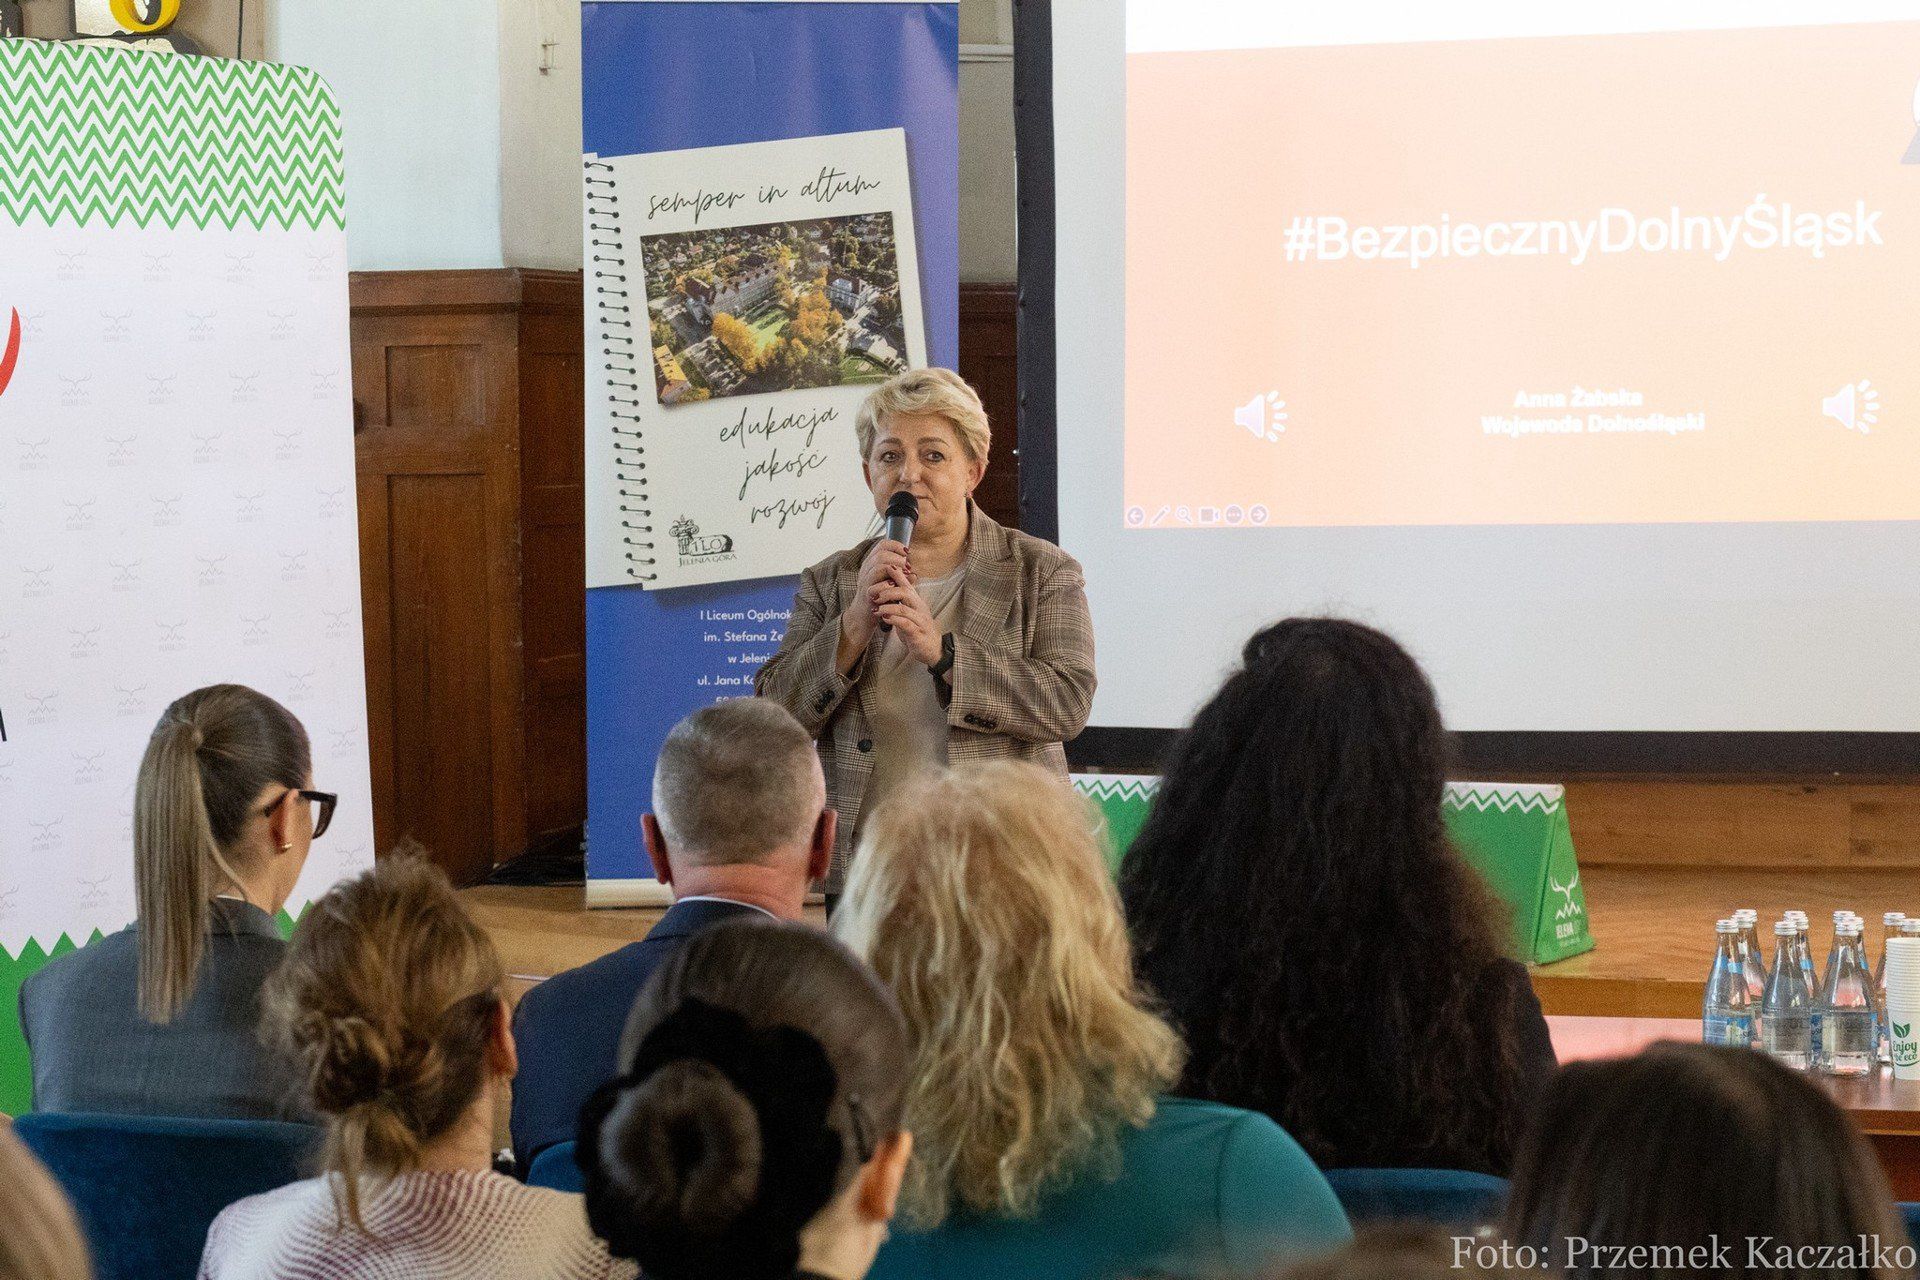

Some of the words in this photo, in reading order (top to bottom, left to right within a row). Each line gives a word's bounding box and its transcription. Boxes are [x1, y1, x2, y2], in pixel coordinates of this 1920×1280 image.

[647, 188, 745, 224] semper
[758, 180, 789, 204] in
[800, 166, 881, 204] altum
[1282, 193, 1884, 269] #BezpiecznyDolnyŚląsk
[1514, 389, 1566, 408] Anna
[719, 406, 839, 449] edukacja
[1481, 414, 1583, 439] Wojewoda
[738, 450, 827, 501] jakość
[750, 489, 836, 530] rozwój
[706, 610, 745, 621] Liceum
[703, 631, 721, 642] im.
[724, 631, 767, 642] Stefana
[727, 655, 736, 664] w
[697, 676, 711, 686] ul.
[714, 675, 741, 686] Jana
[1893, 1040, 1918, 1055] Enjoy
